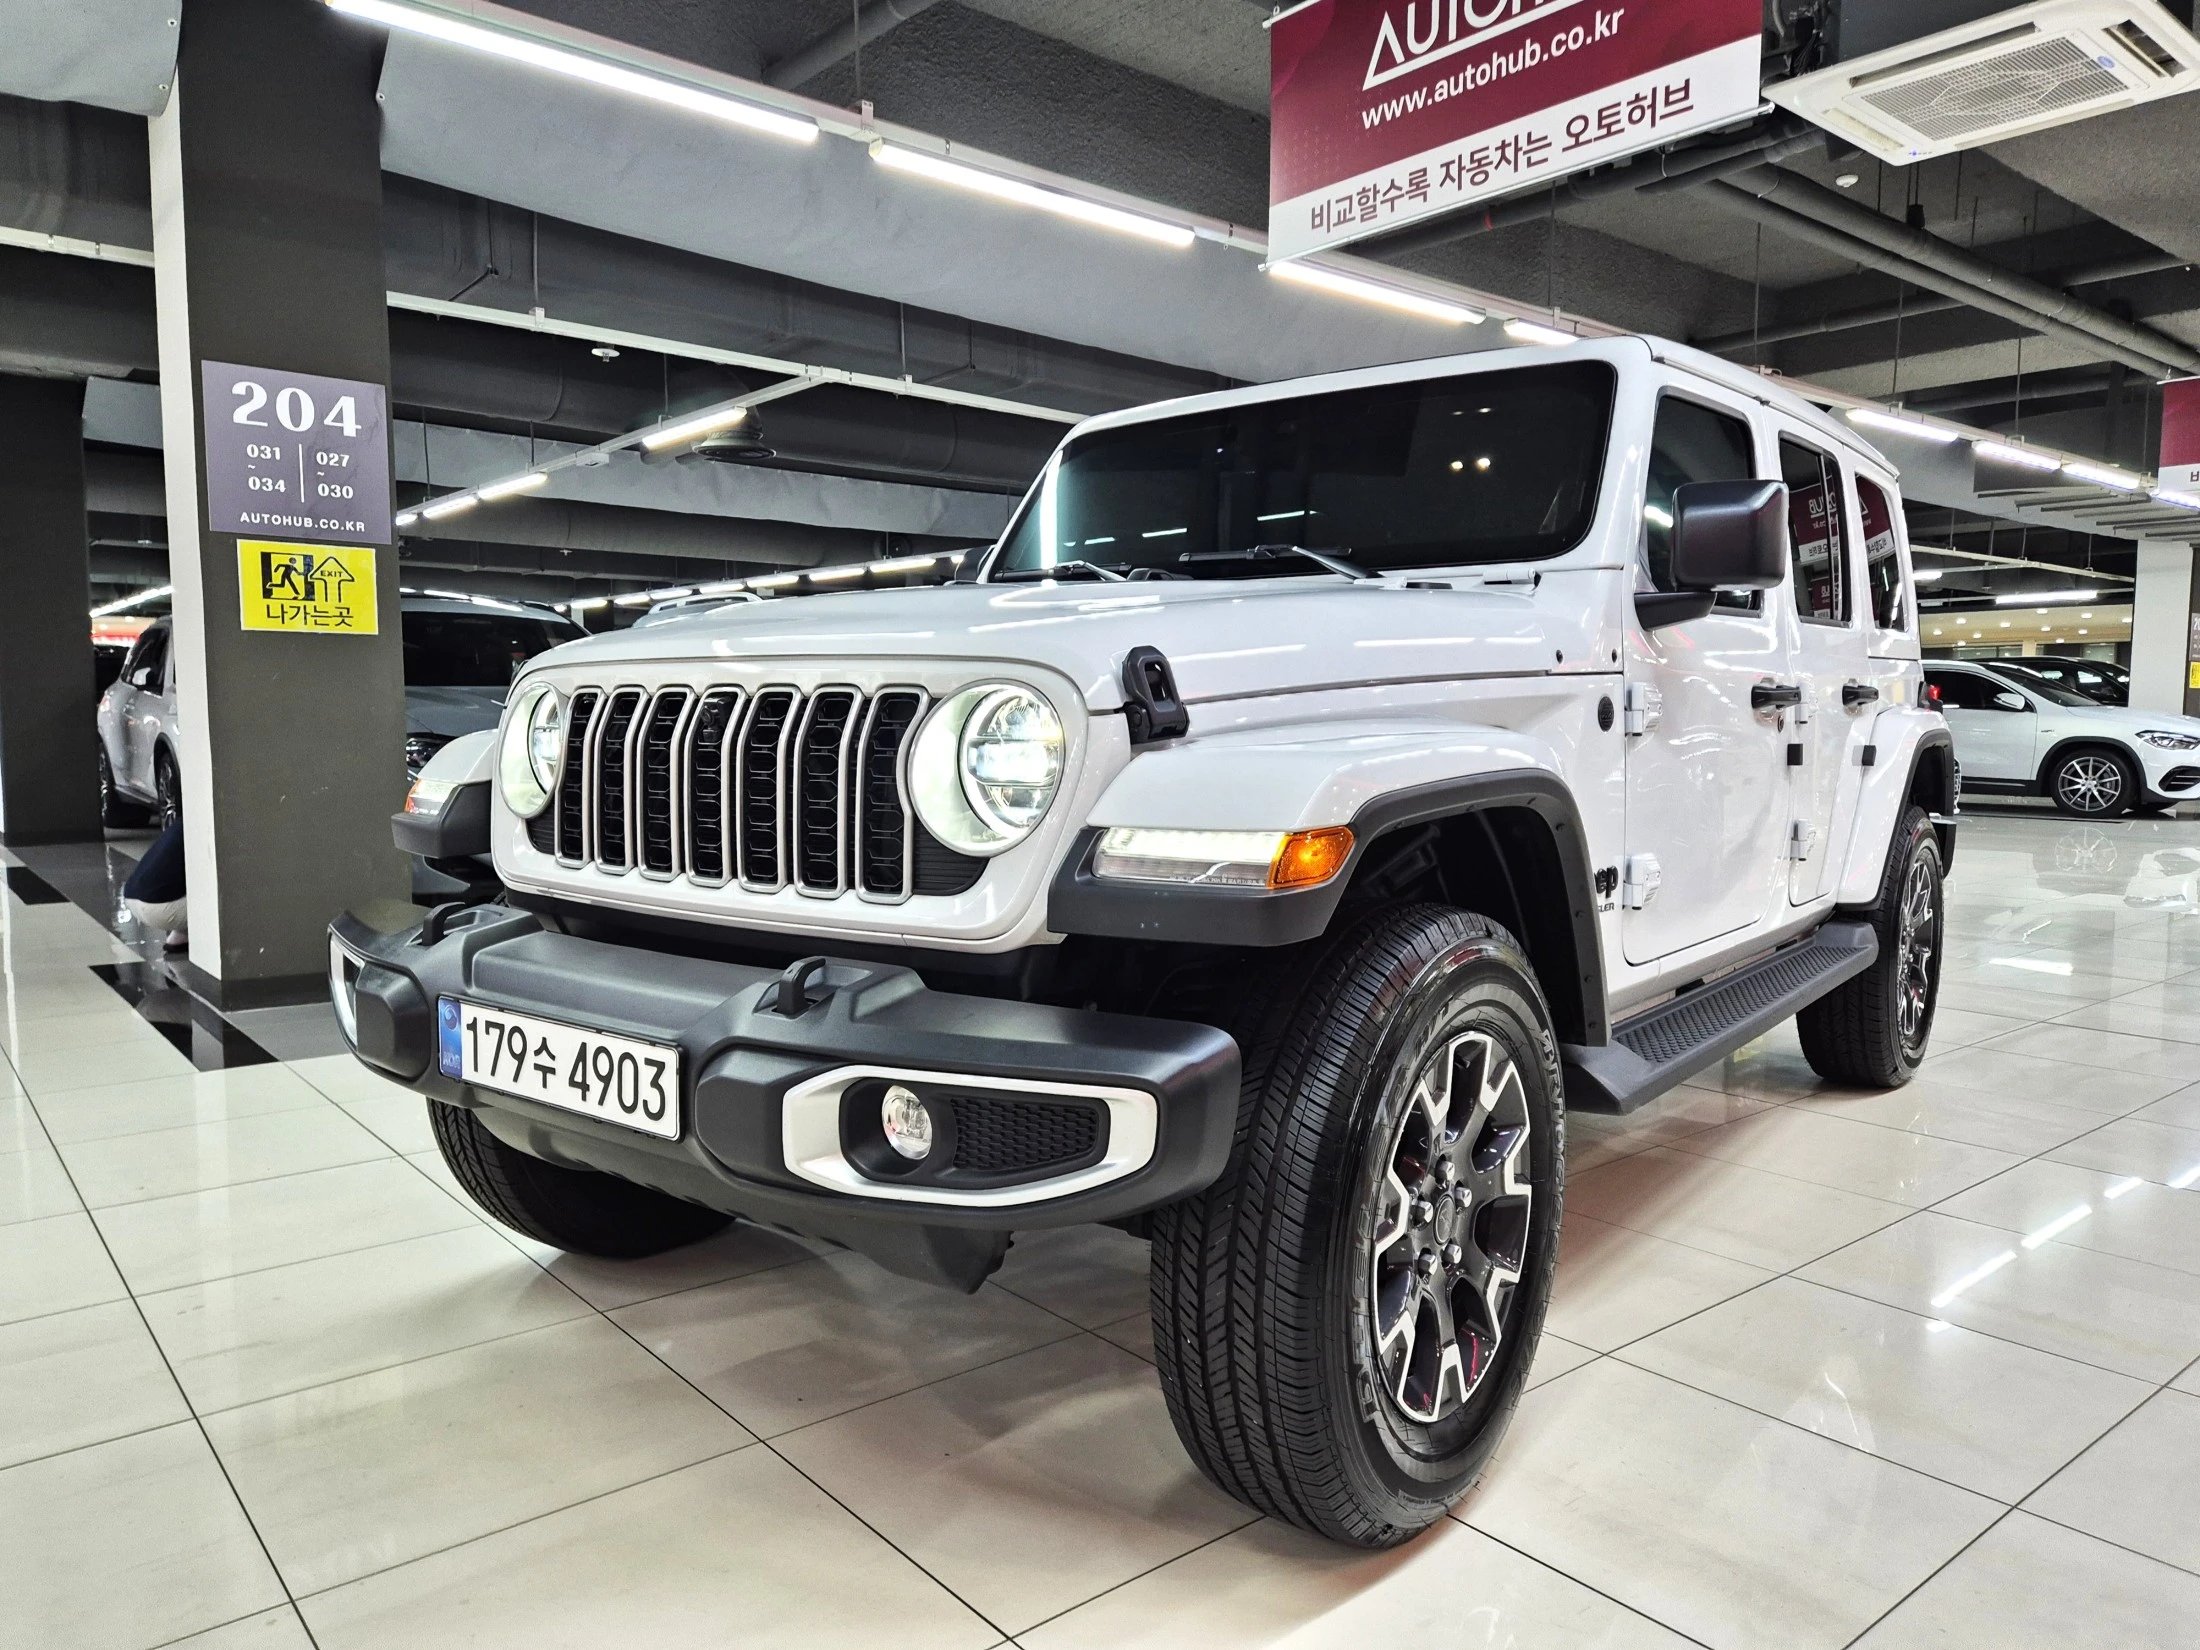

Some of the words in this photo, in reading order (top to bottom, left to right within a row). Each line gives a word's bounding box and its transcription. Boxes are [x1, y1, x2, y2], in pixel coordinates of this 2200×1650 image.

[1362, 0, 1544, 91] AUTO
[1362, 8, 1625, 130] www.autohub.co.kr
[1311, 166, 1431, 234] 비교할수록
[1439, 130, 1552, 192] 자동차는
[1562, 78, 1694, 153] 오토허브
[232, 381, 362, 438] 204
[246, 444, 281, 461] 031
[316, 452, 350, 467] 027
[248, 476, 287, 493] 034
[317, 484, 354, 499] 030
[240, 512, 365, 532] AUTOHUB.CO.KR
[320, 570, 343, 578] EXIT
[266, 603, 354, 627] 나가는곳
[1594, 866, 1618, 899] ep
[443, 1051, 460, 1070] KOR
[466, 1016, 556, 1089] 179수
[568, 1041, 667, 1121] 4903
